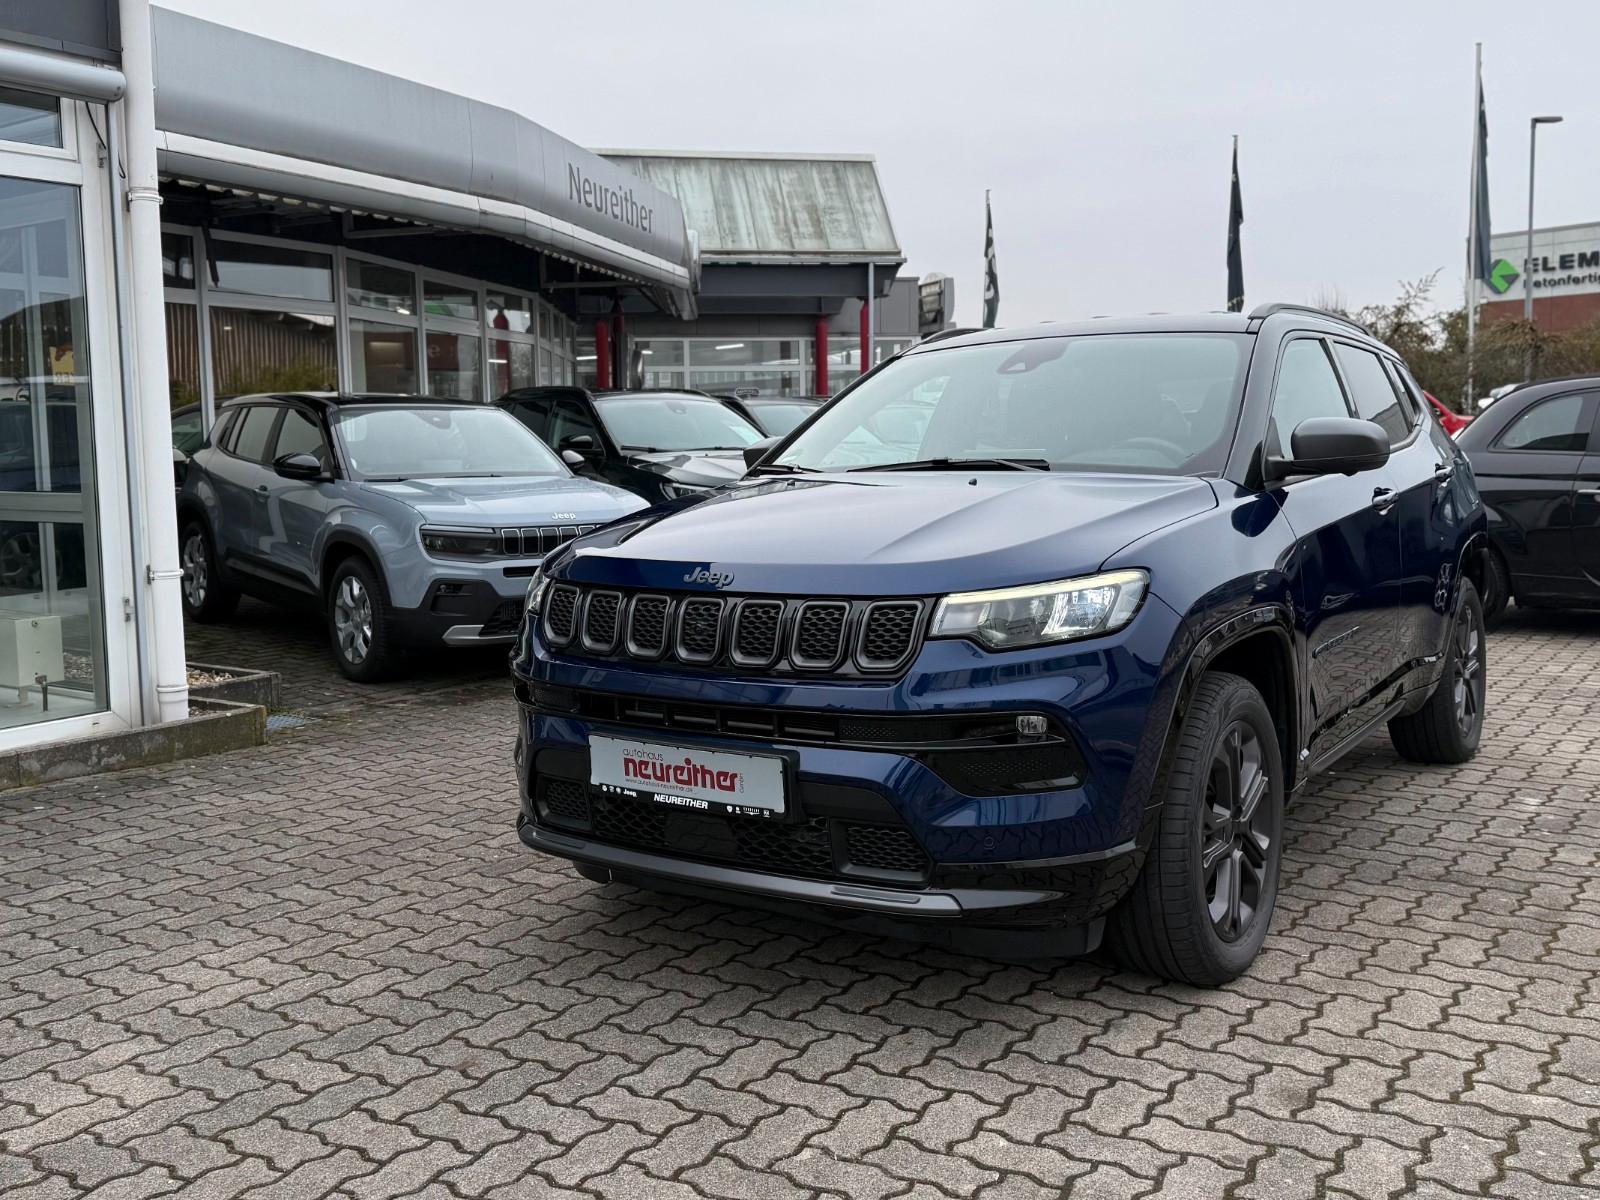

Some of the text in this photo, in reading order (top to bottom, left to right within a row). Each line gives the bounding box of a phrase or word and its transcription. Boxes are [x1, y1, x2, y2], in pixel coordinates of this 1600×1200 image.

[568, 162, 653, 234] Neureither
[551, 511, 577, 520] Jeep
[683, 566, 734, 589] Jeep
[623, 748, 664, 761] autohaus
[623, 757, 738, 793] neureither
[653, 793, 709, 810] NEUREITHER
